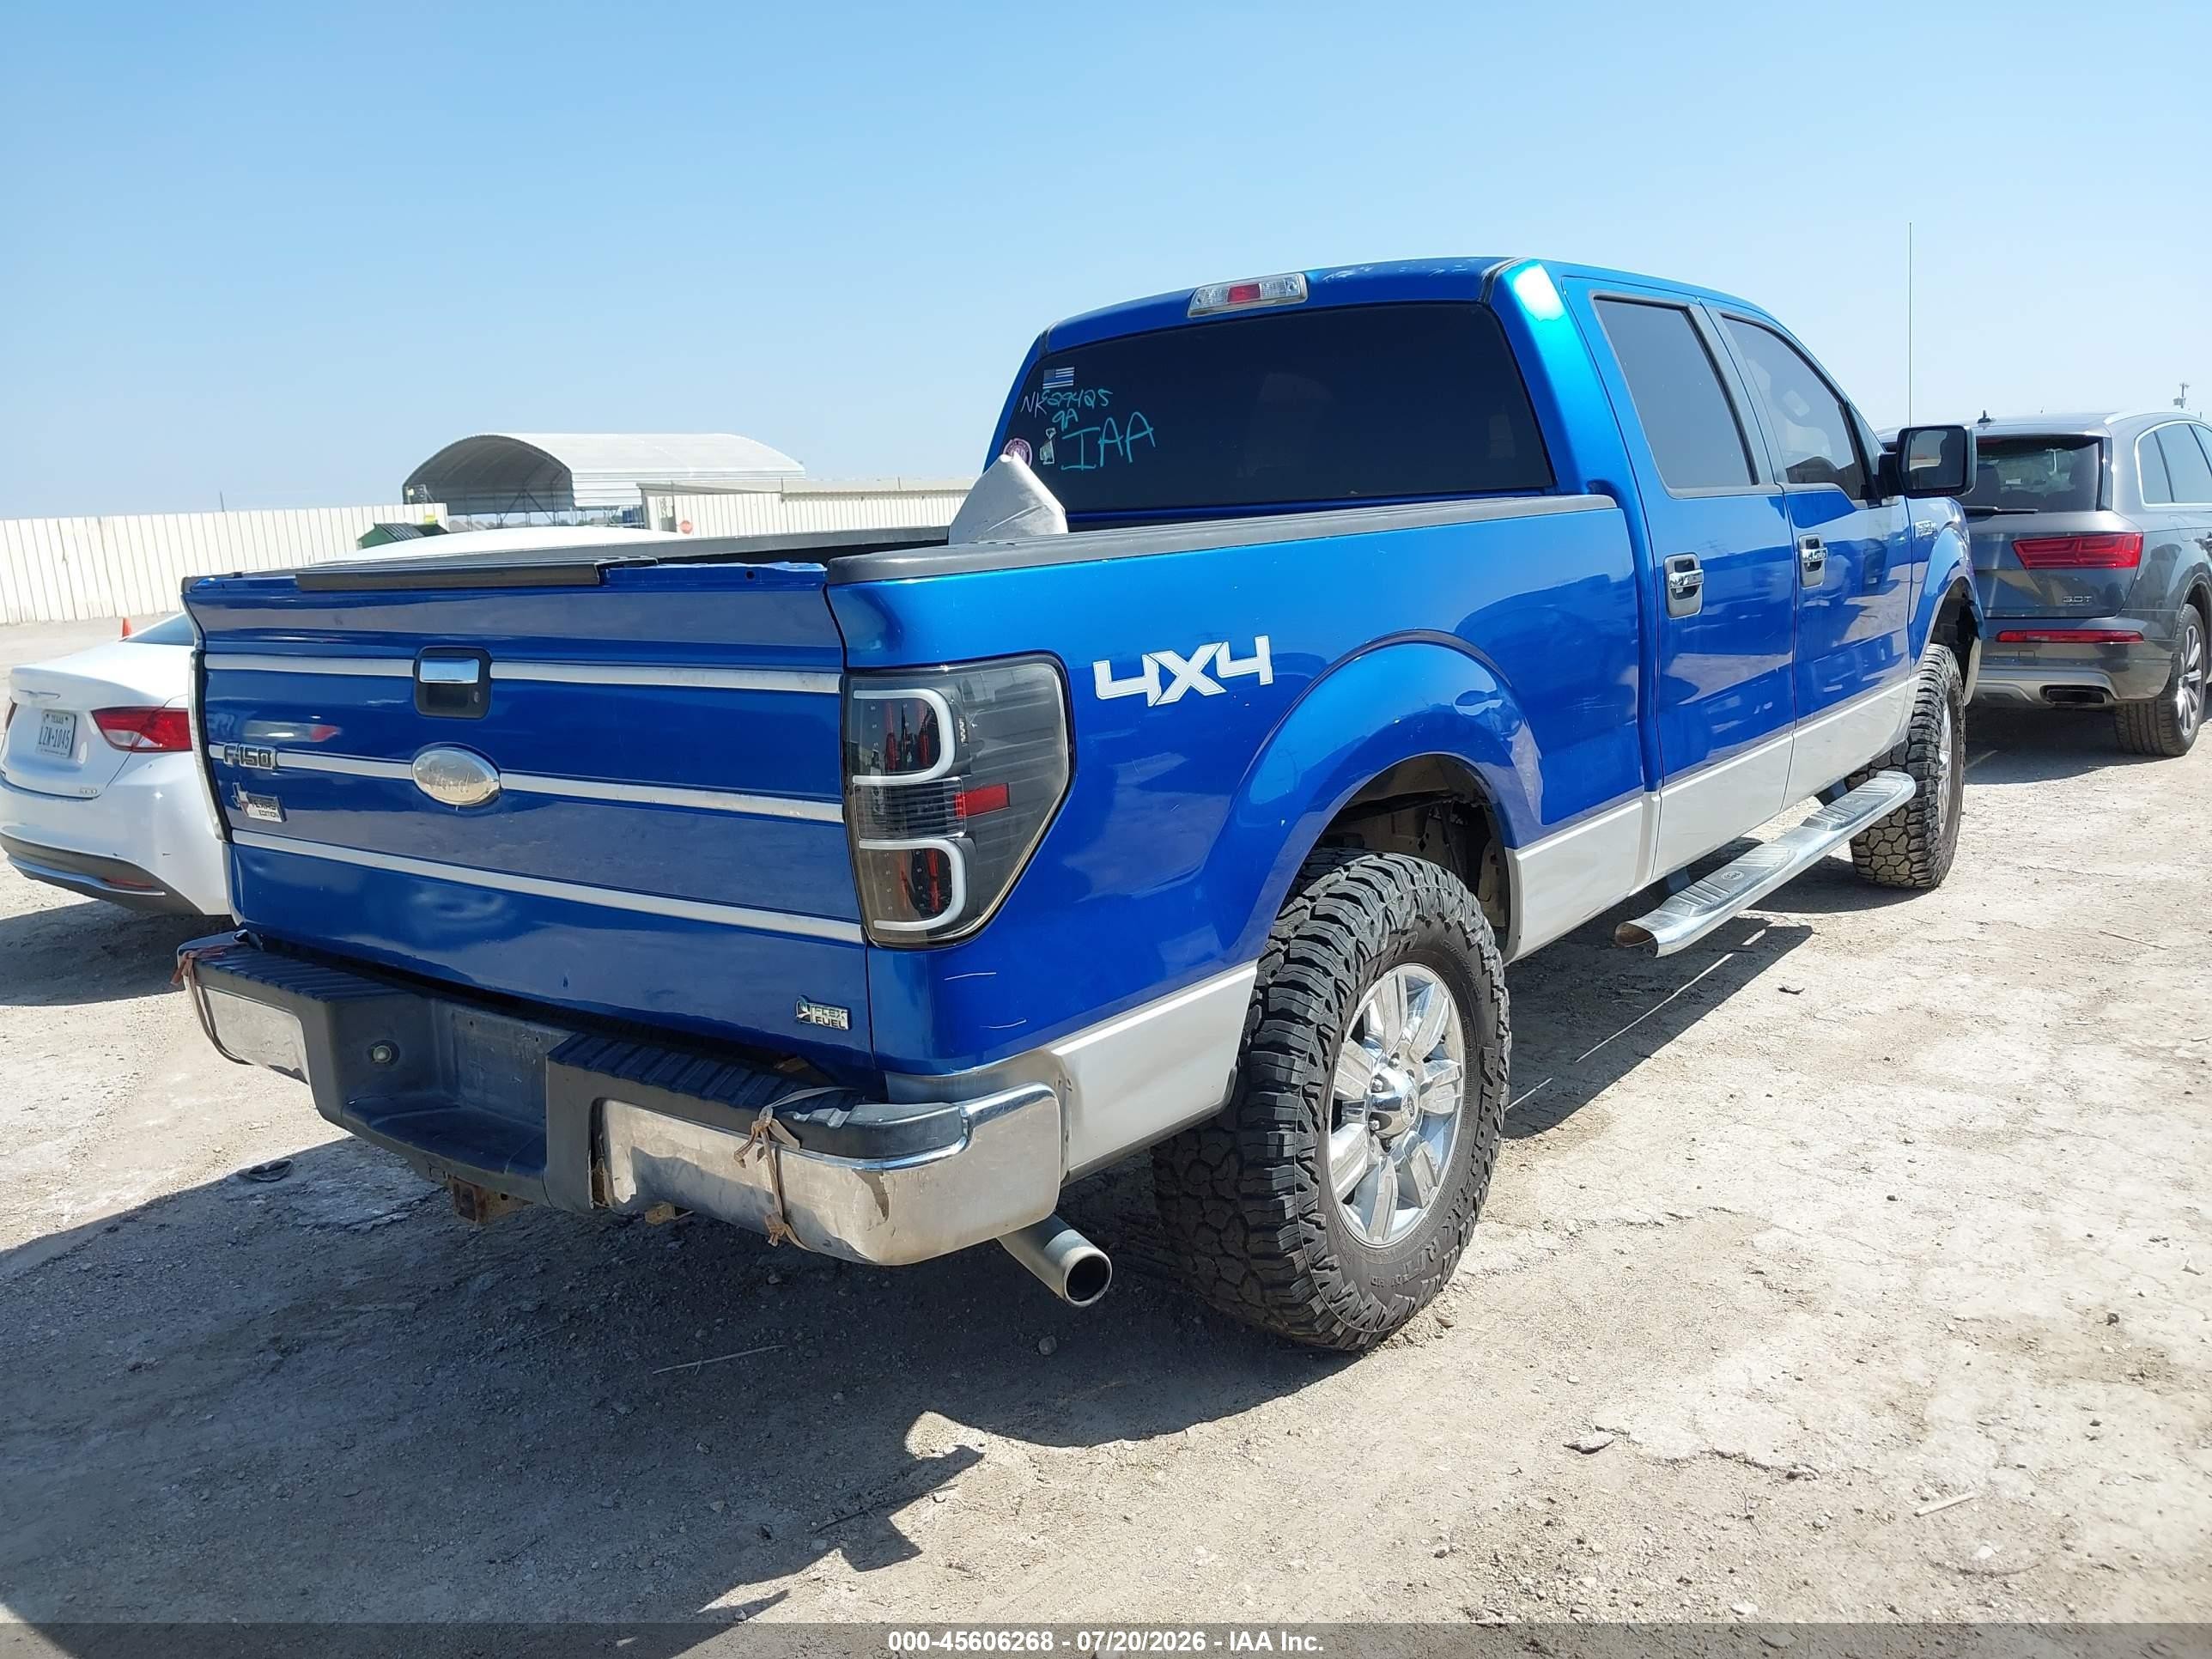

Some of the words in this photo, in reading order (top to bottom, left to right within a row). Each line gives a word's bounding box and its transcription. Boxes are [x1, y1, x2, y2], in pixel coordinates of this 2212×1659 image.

[1060, 411, 1156, 471] IAA
[223, 743, 275, 769] F-150
[813, 1006, 845, 1019] FLEX
[815, 1016, 846, 1029] FUEL
